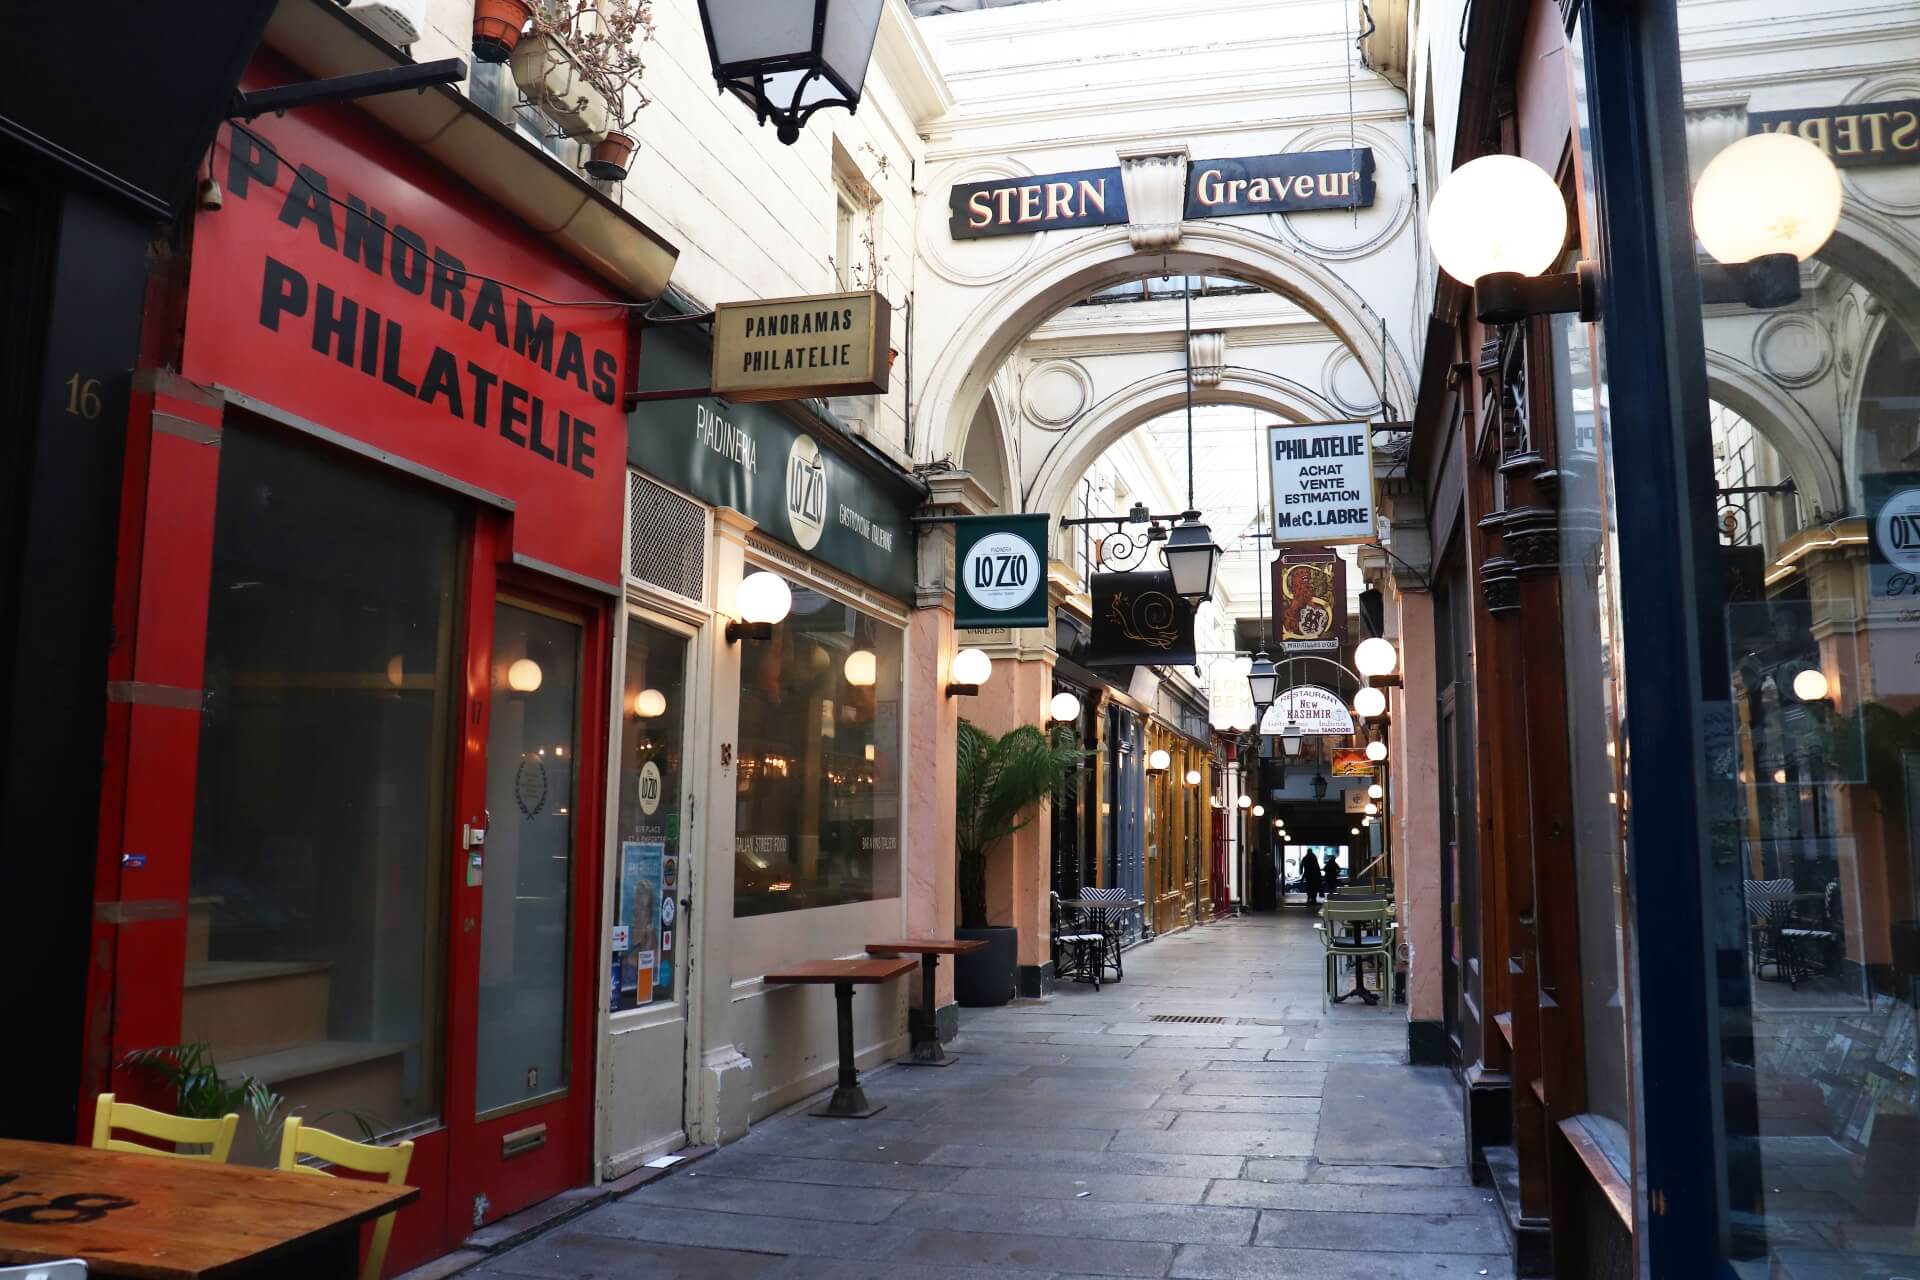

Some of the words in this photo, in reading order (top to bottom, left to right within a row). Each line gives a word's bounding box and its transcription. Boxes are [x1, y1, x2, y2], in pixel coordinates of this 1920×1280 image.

[966, 176, 1106, 229] STERN
[1197, 168, 1361, 207] Graveur
[226, 124, 618, 406] PANORAMAS
[745, 308, 852, 338] PANORAMAS
[258, 256, 597, 480] PHILATELIE
[743, 344, 851, 373] PHILATELIE
[64, 371, 103, 420] 16
[696, 403, 757, 475] PIADINERIA
[1275, 434, 1365, 461] PHILATELIE
[1298, 463, 1344, 477] ACHAT
[1299, 477, 1345, 491] VENTE
[1284, 489, 1360, 505] ESTIMATION
[1280, 690, 1339, 706] RESTAURANT
[1287, 709, 1332, 719] KASHMIR
